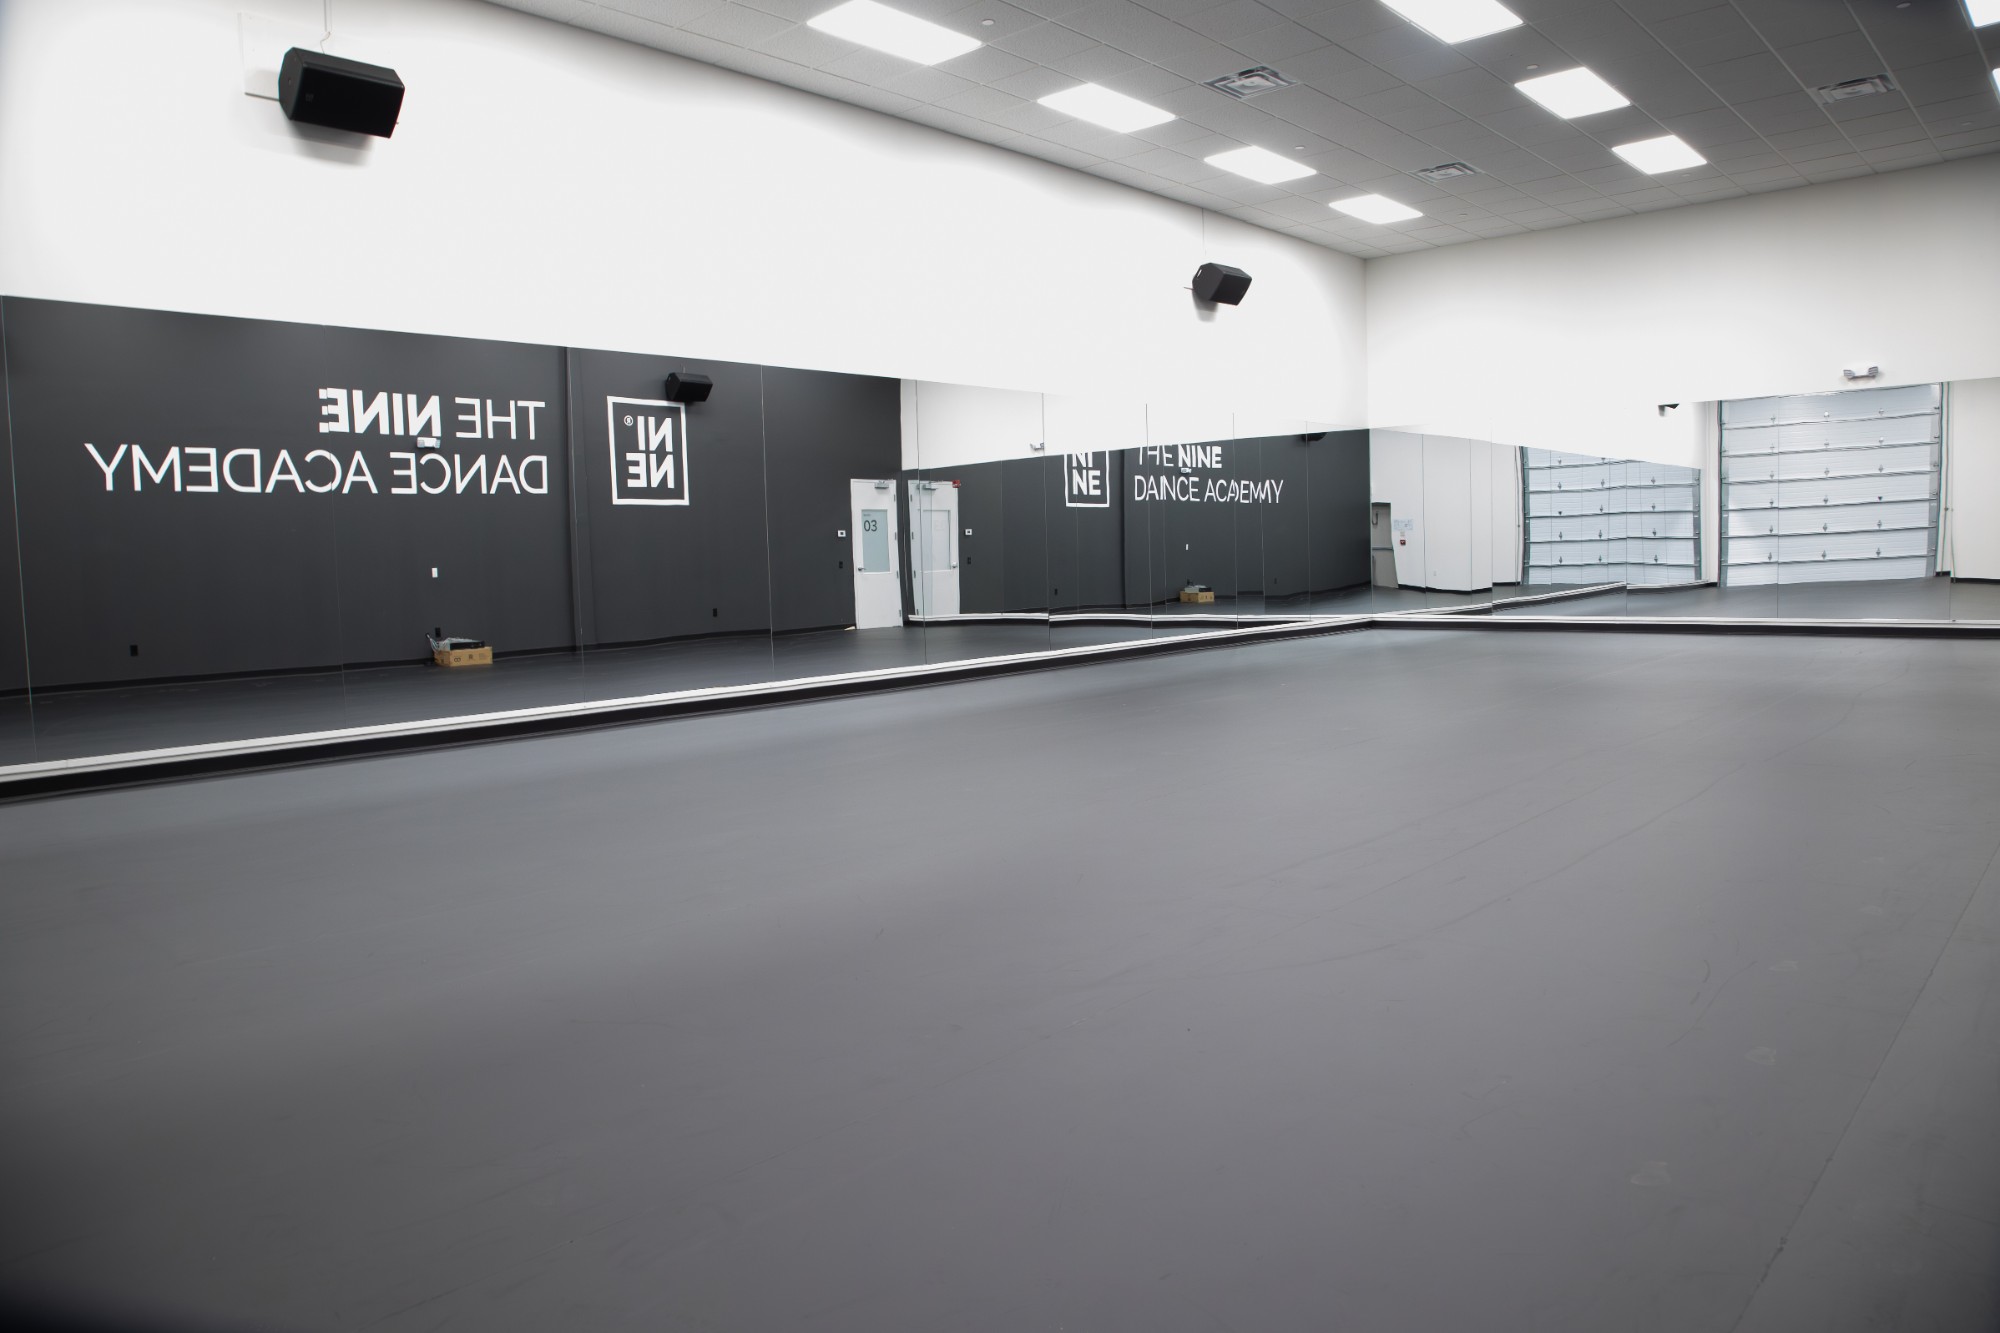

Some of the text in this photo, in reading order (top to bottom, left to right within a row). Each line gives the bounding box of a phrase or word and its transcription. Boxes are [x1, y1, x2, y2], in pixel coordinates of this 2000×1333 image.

[1177, 443, 1223, 469] NINE
[1072, 468, 1102, 496] NE
[863, 519, 878, 532] 03
